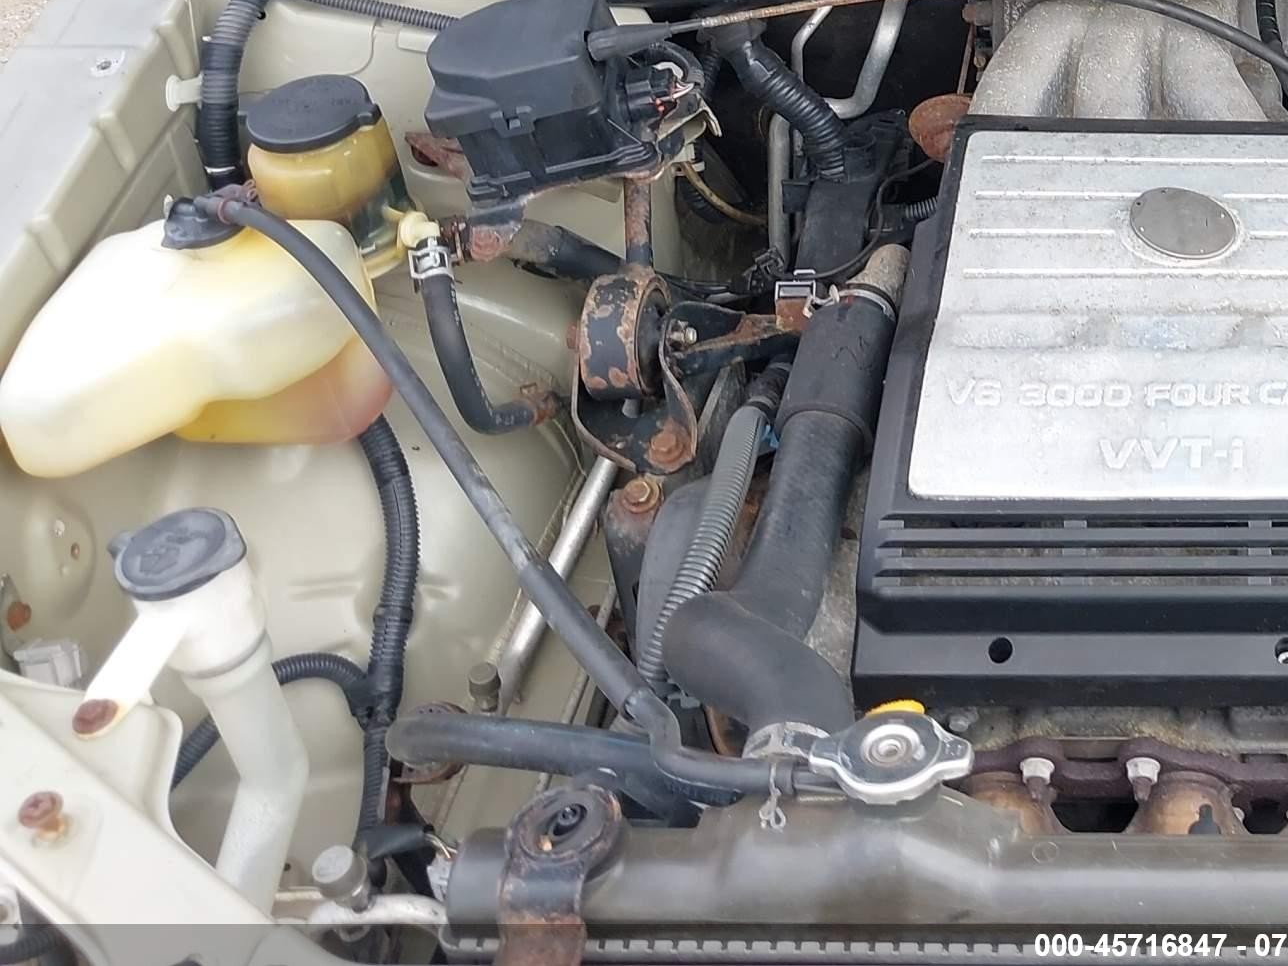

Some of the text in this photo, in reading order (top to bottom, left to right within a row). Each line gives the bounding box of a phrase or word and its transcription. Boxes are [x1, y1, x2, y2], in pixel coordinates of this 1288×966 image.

[945, 379, 1002, 406] V6
[1019, 383, 1132, 408] 3000
[1145, 381, 1251, 407] FOUR
[1098, 437, 1245, 470] VVT-i
